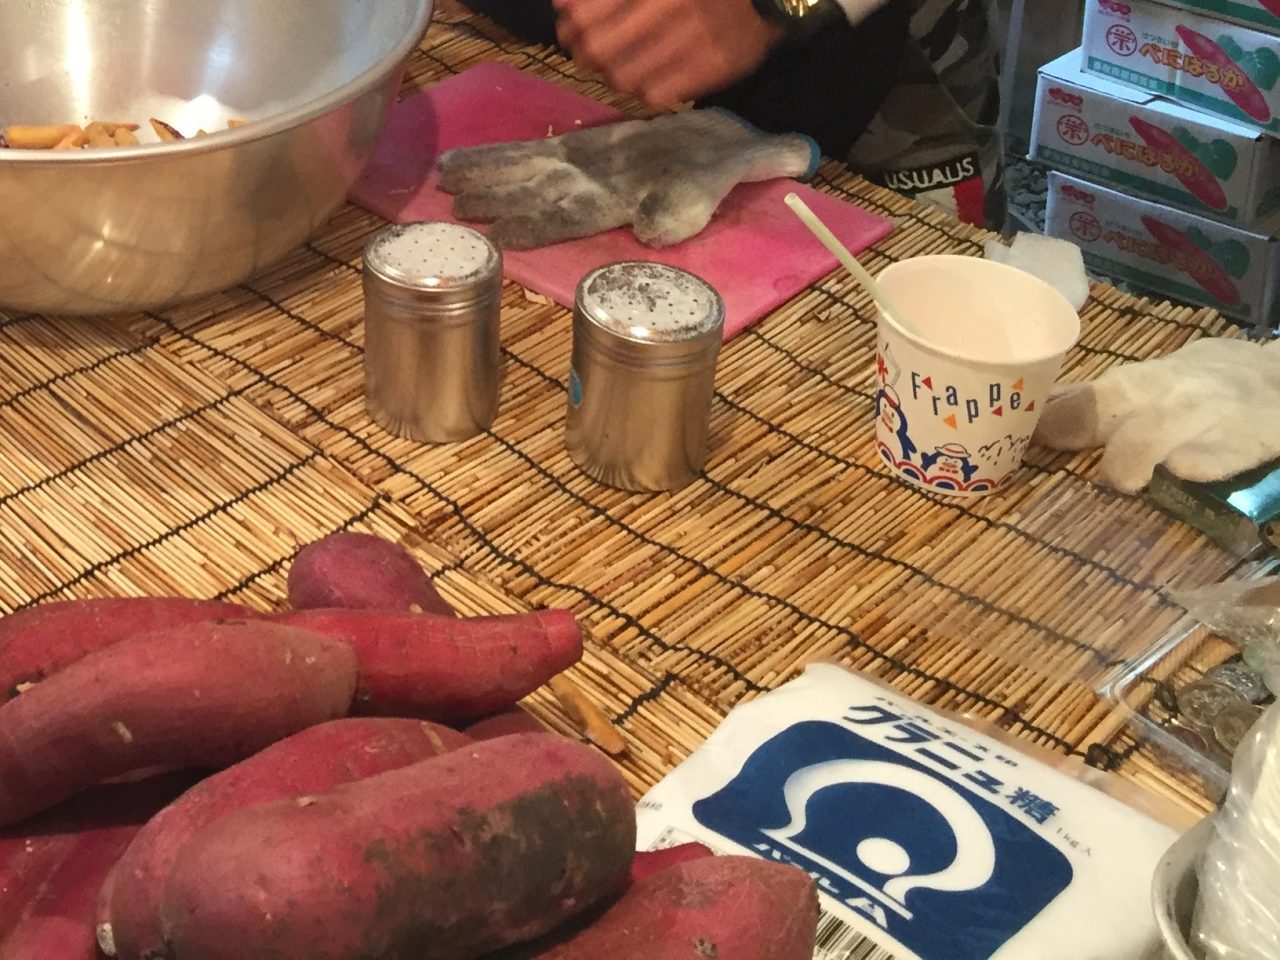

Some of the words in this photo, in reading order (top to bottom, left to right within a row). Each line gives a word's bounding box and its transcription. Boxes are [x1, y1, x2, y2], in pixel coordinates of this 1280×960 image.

[1139, 42, 1243, 90] べにはるか
[1091, 132, 1199, 178] べにはるか
[911, 371, 1022, 424] Frappe
[842, 704, 1060, 825] グラニュ糖
